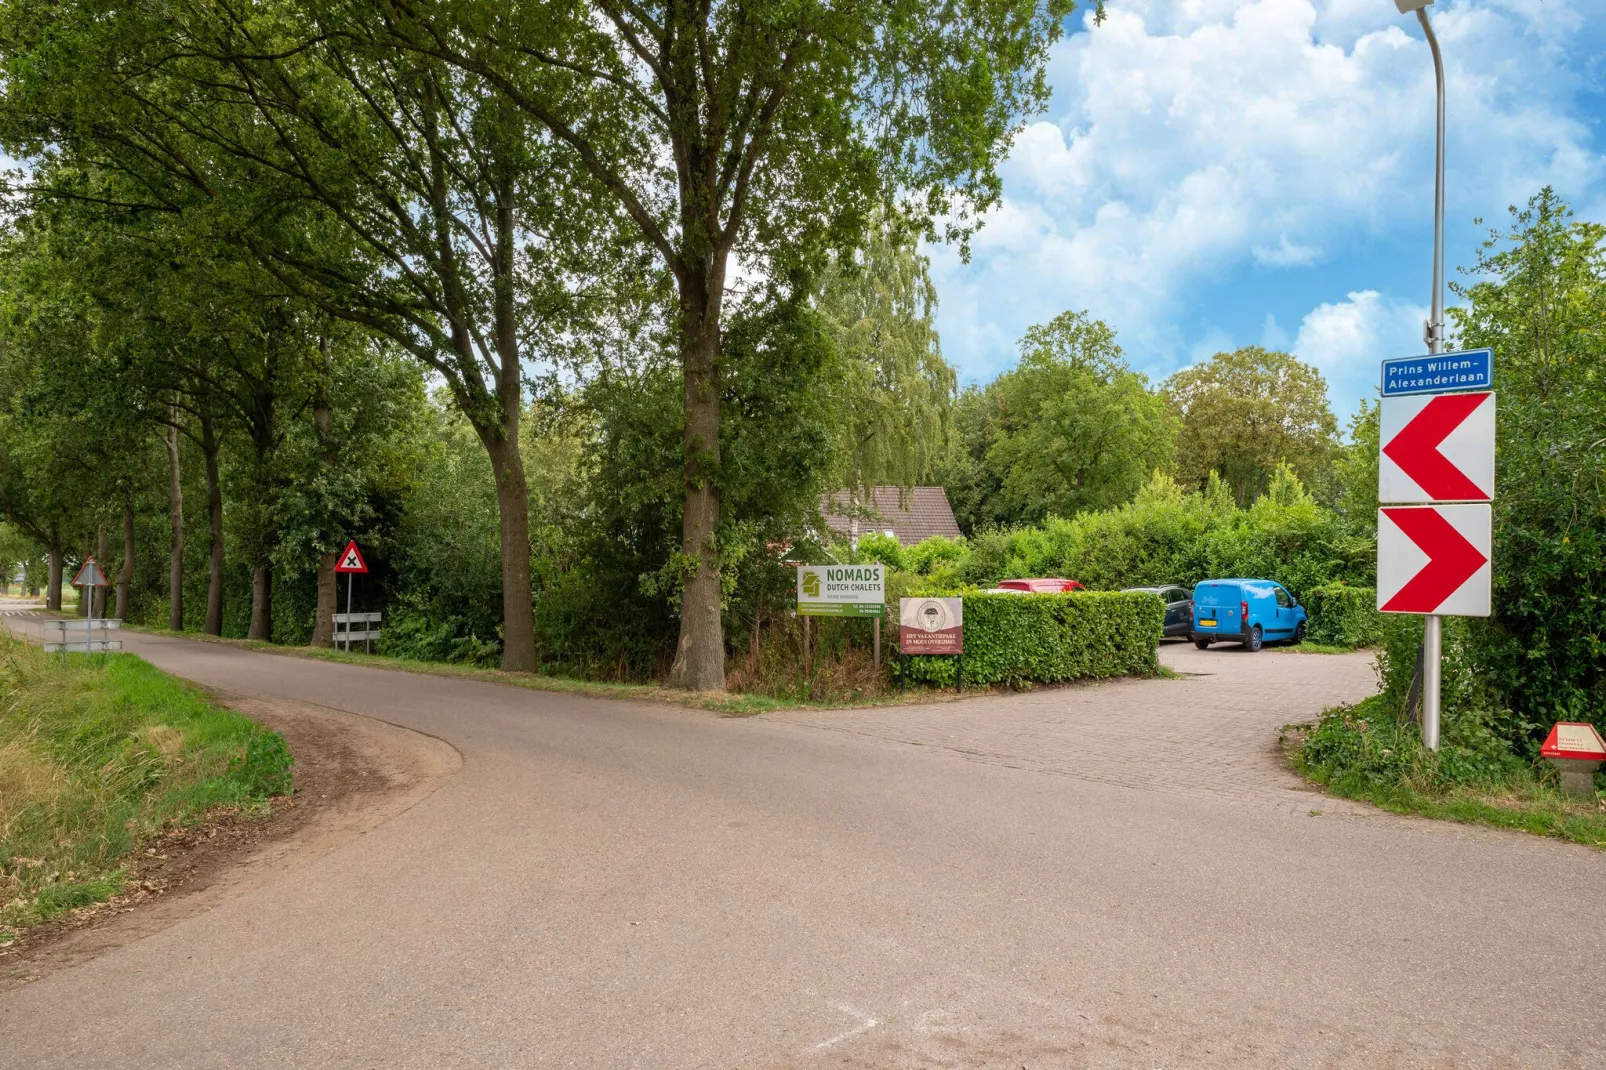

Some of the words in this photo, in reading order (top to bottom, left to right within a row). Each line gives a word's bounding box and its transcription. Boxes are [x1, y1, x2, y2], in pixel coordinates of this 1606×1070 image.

[1389, 366, 1423, 376] Prins
[1427, 360, 1479, 372] Willem-
[1388, 373, 1484, 388] Alexanderlaan
[827, 568, 880, 582] NOMADS
[827, 583, 849, 591] DUTCH
[850, 583, 881, 591] CHALETS
